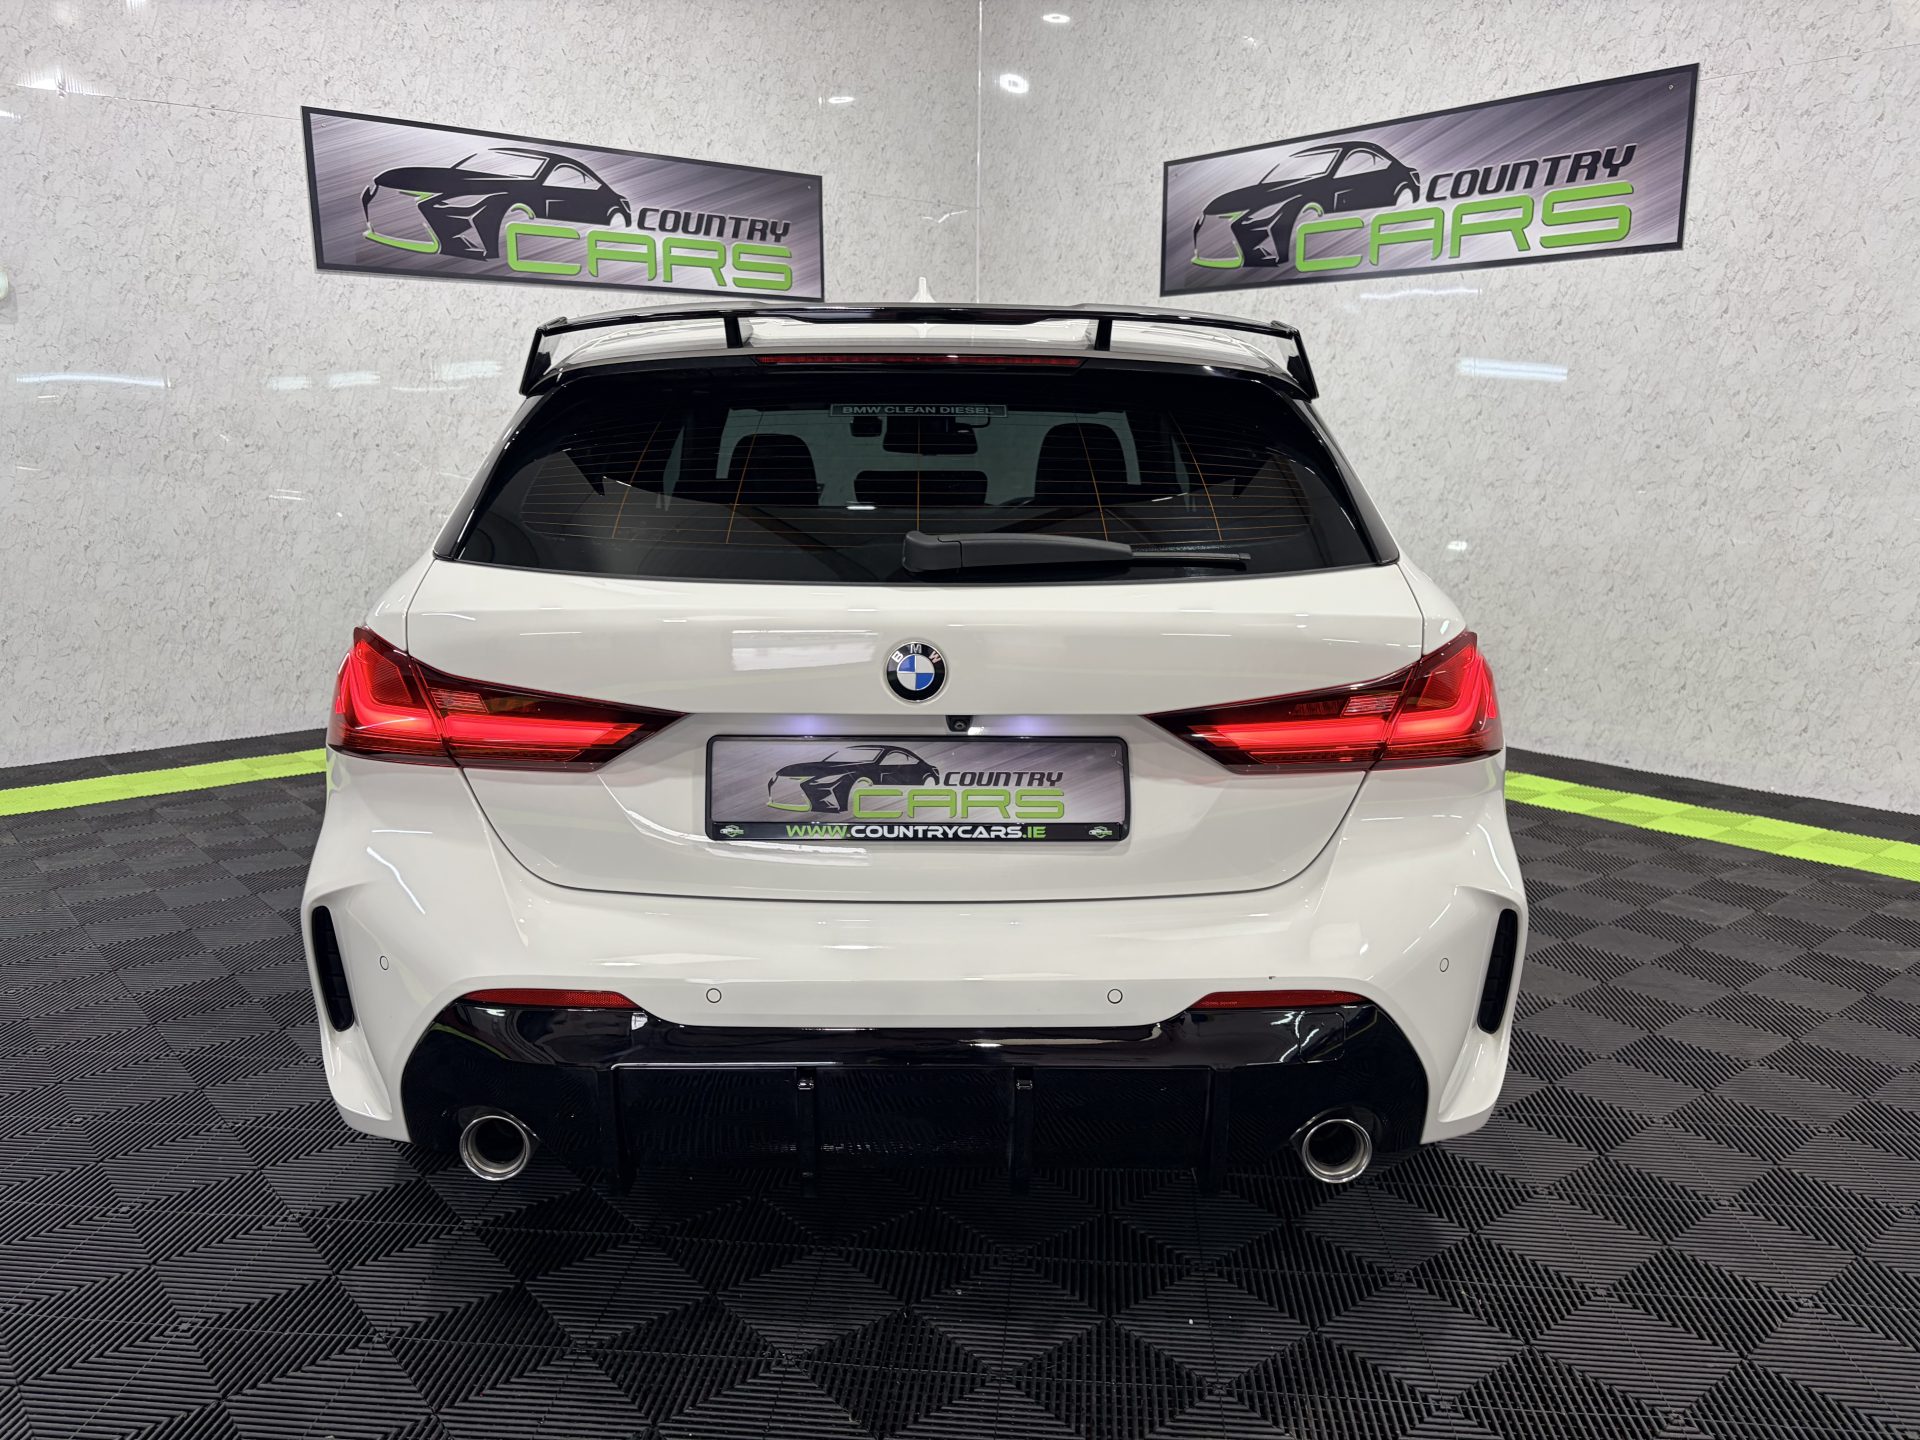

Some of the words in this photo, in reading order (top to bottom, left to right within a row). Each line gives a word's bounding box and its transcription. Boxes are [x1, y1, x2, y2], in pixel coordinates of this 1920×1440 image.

[1427, 145, 1637, 202] COUNTRY
[638, 207, 791, 242] COUNTRY
[1295, 182, 1634, 273] CARS
[506, 223, 792, 291] CARS
[842, 406, 881, 414] BMW
[884, 406, 936, 414] CLEAN
[939, 406, 993, 415] DIESEL
[891, 643, 942, 663] BMW
[943, 772, 1064, 787] COUNTRY
[852, 789, 1065, 819] CARS
[786, 825, 1046, 839] WWW.COUNTRYCARS.IE
